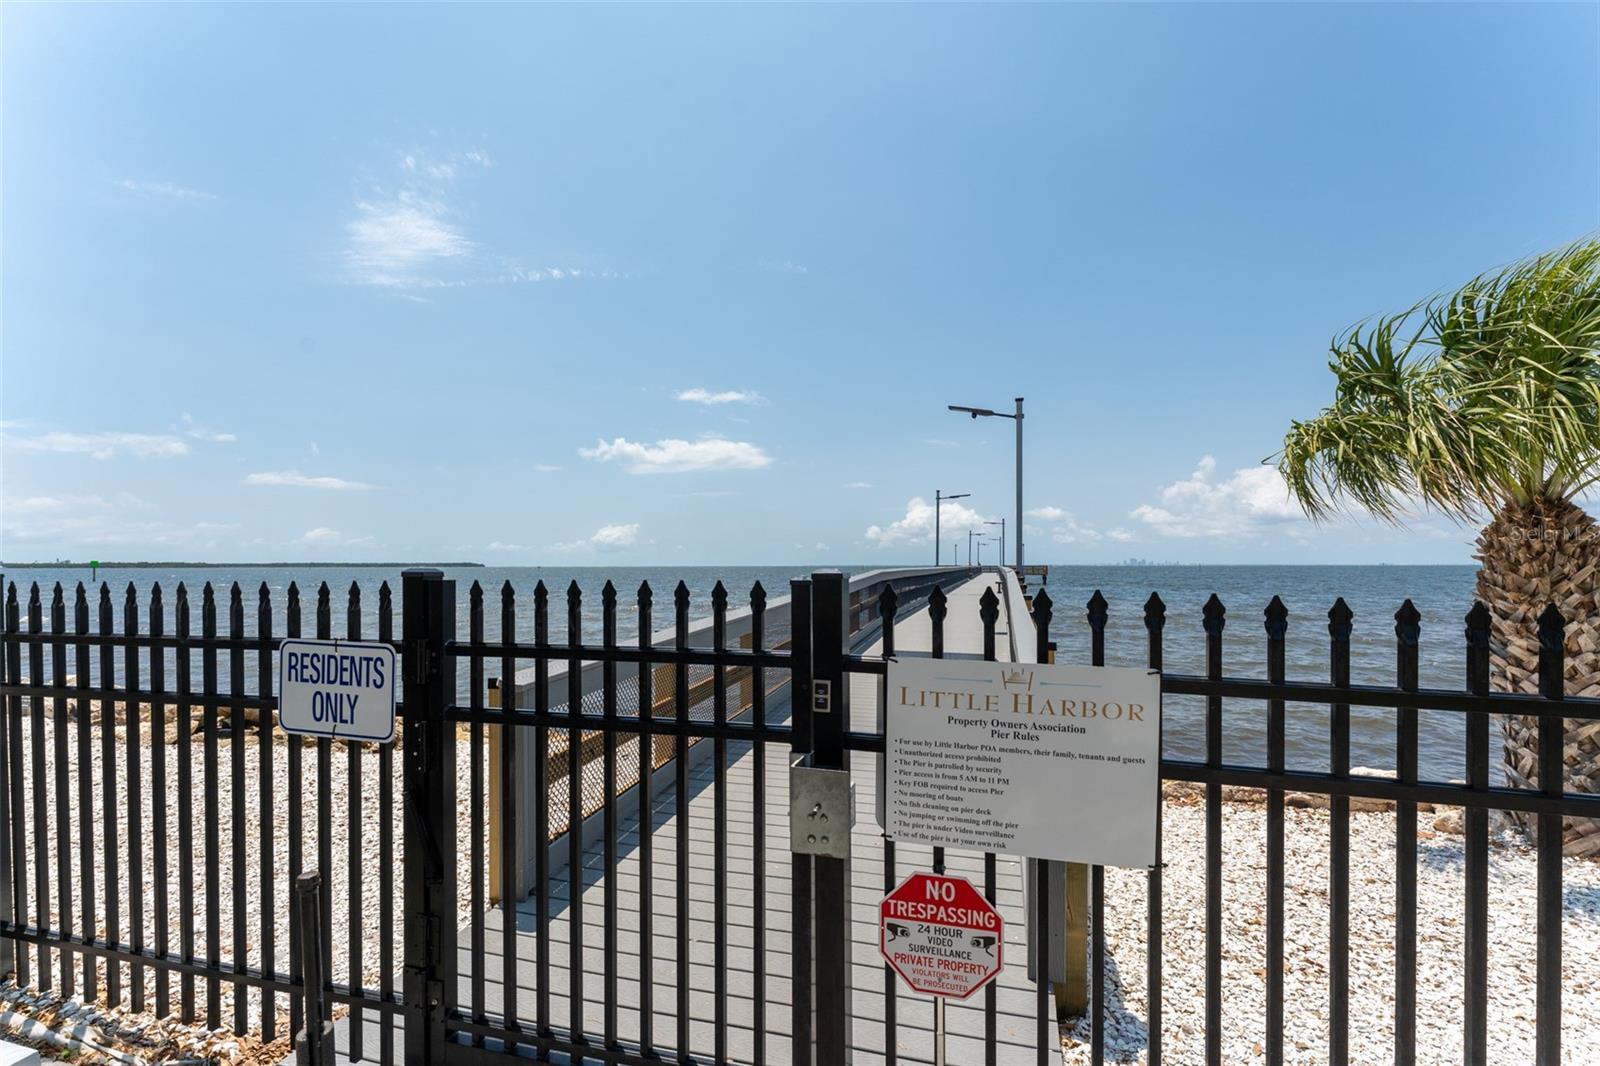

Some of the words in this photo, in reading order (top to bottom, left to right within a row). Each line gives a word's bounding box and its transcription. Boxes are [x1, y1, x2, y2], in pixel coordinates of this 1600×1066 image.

[287, 652, 385, 689] RESIDENTS
[312, 691, 359, 725] ONLY
[899, 686, 999, 712] LITTLE
[1011, 693, 1145, 721] HARBOR
[947, 715, 988, 728] Property
[991, 719, 1028, 730] Owners
[1031, 722, 1086, 734] Association
[990, 729, 1010, 739] Pier
[1013, 731, 1040, 741] Rules
[899, 748, 943, 758] Unauthorized
[966, 753, 1002, 763] prohibited
[924, 739, 932, 749] by
[934, 741, 951, 749] Little
[954, 742, 979, 750] Harbor
[980, 744, 997, 752] POA
[1079, 753, 1105, 761] tenants
[934, 762, 964, 771] patrolled
[965, 764, 974, 773] by
[976, 765, 1002, 775] security
[941, 772, 958, 780] from
[898, 780, 911, 788] Key
[930, 782, 958, 793] required
[909, 791, 936, 800] mooring
[946, 794, 963, 802] boats
[922, 802, 949, 812] cleaning
[961, 806, 974, 814] pier
[909, 811, 936, 821] jumping
[946, 816, 979, 826] swimming
[1005, 821, 1019, 829] pier
[912, 822, 924, 830] pier
[926, 822, 932, 830] is
[933, 824, 953, 832] under
[954, 826, 973, 834] Video
[975, 828, 1015, 839] surveillance
[930, 833, 944, 842] pier
[960, 837, 976, 846] your
[993, 841, 1006, 849] risk
[926, 880, 956, 902] NO
[887, 899, 996, 928] TRESPASSING
[917, 924, 930, 934] 24
[934, 926, 963, 938] HOUR
[927, 936, 953, 947] VIDEO
[908, 944, 972, 960] SURVEILLANCE
[894, 952, 933, 968] PRIVATE
[937, 958, 989, 975] PROPERTY
[912, 968, 950, 980] VIOLATORS
[953, 974, 969, 983] WILL
[912, 978, 922, 986] BE
[923, 979, 968, 992] PROSECUTED
